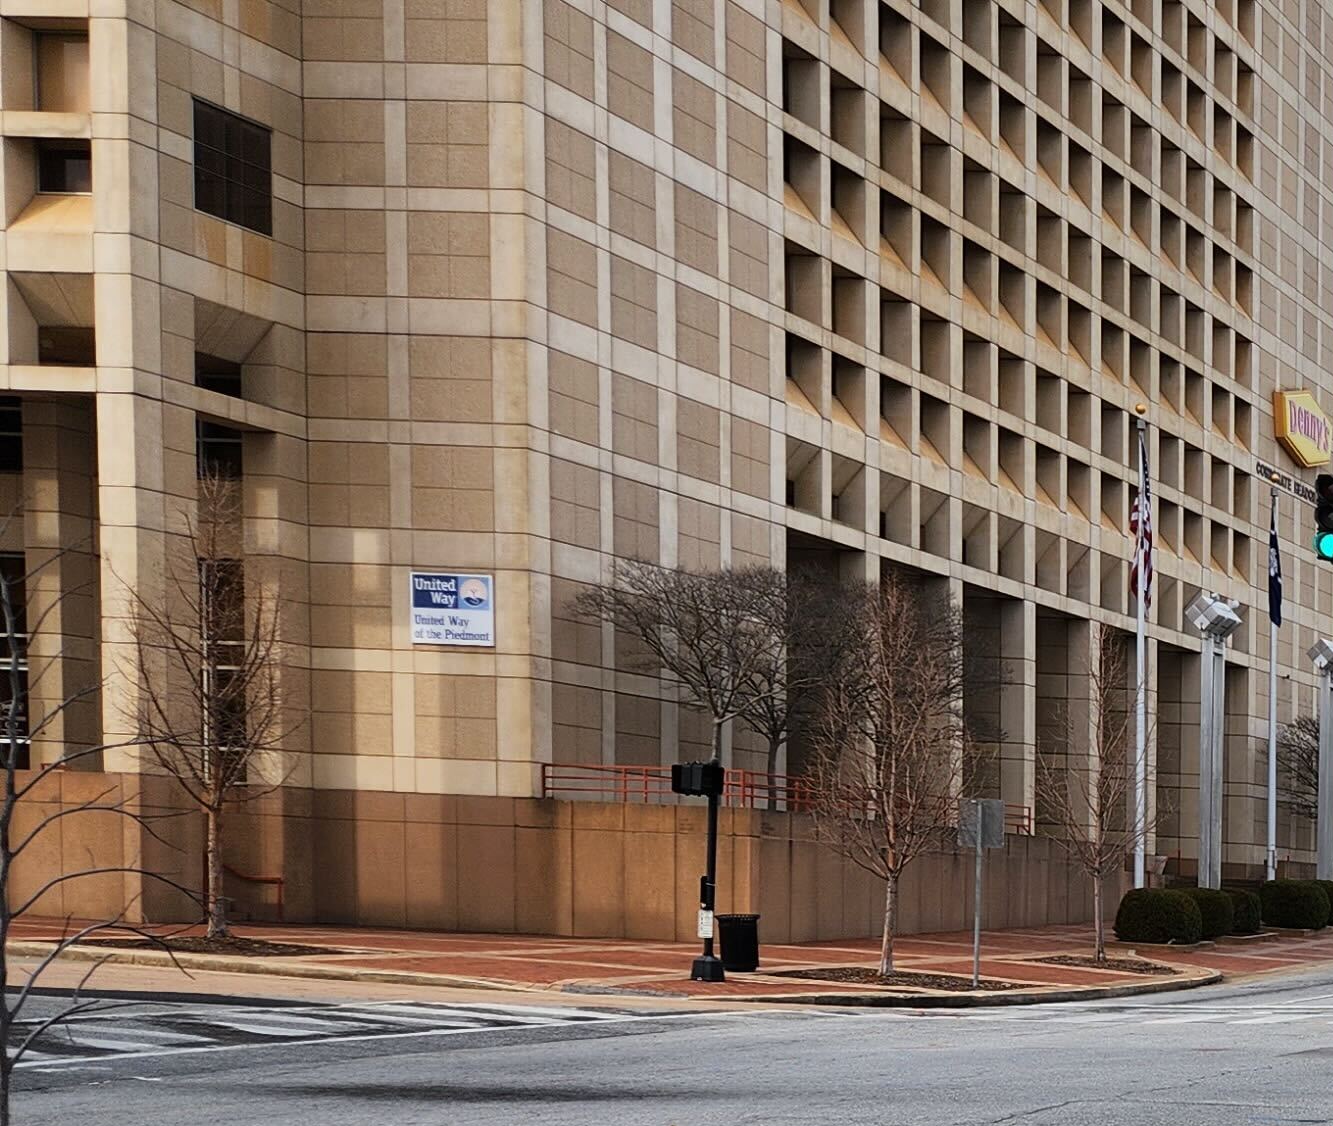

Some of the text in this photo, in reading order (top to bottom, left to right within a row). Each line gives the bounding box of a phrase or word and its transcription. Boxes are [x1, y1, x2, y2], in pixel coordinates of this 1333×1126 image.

[1289, 400, 1329, 452] Denny's
[414, 577, 457, 591] United
[430, 592, 456, 608] Way
[414, 614, 469, 628] United Way
[415, 628, 490, 641] of the Piedmont
